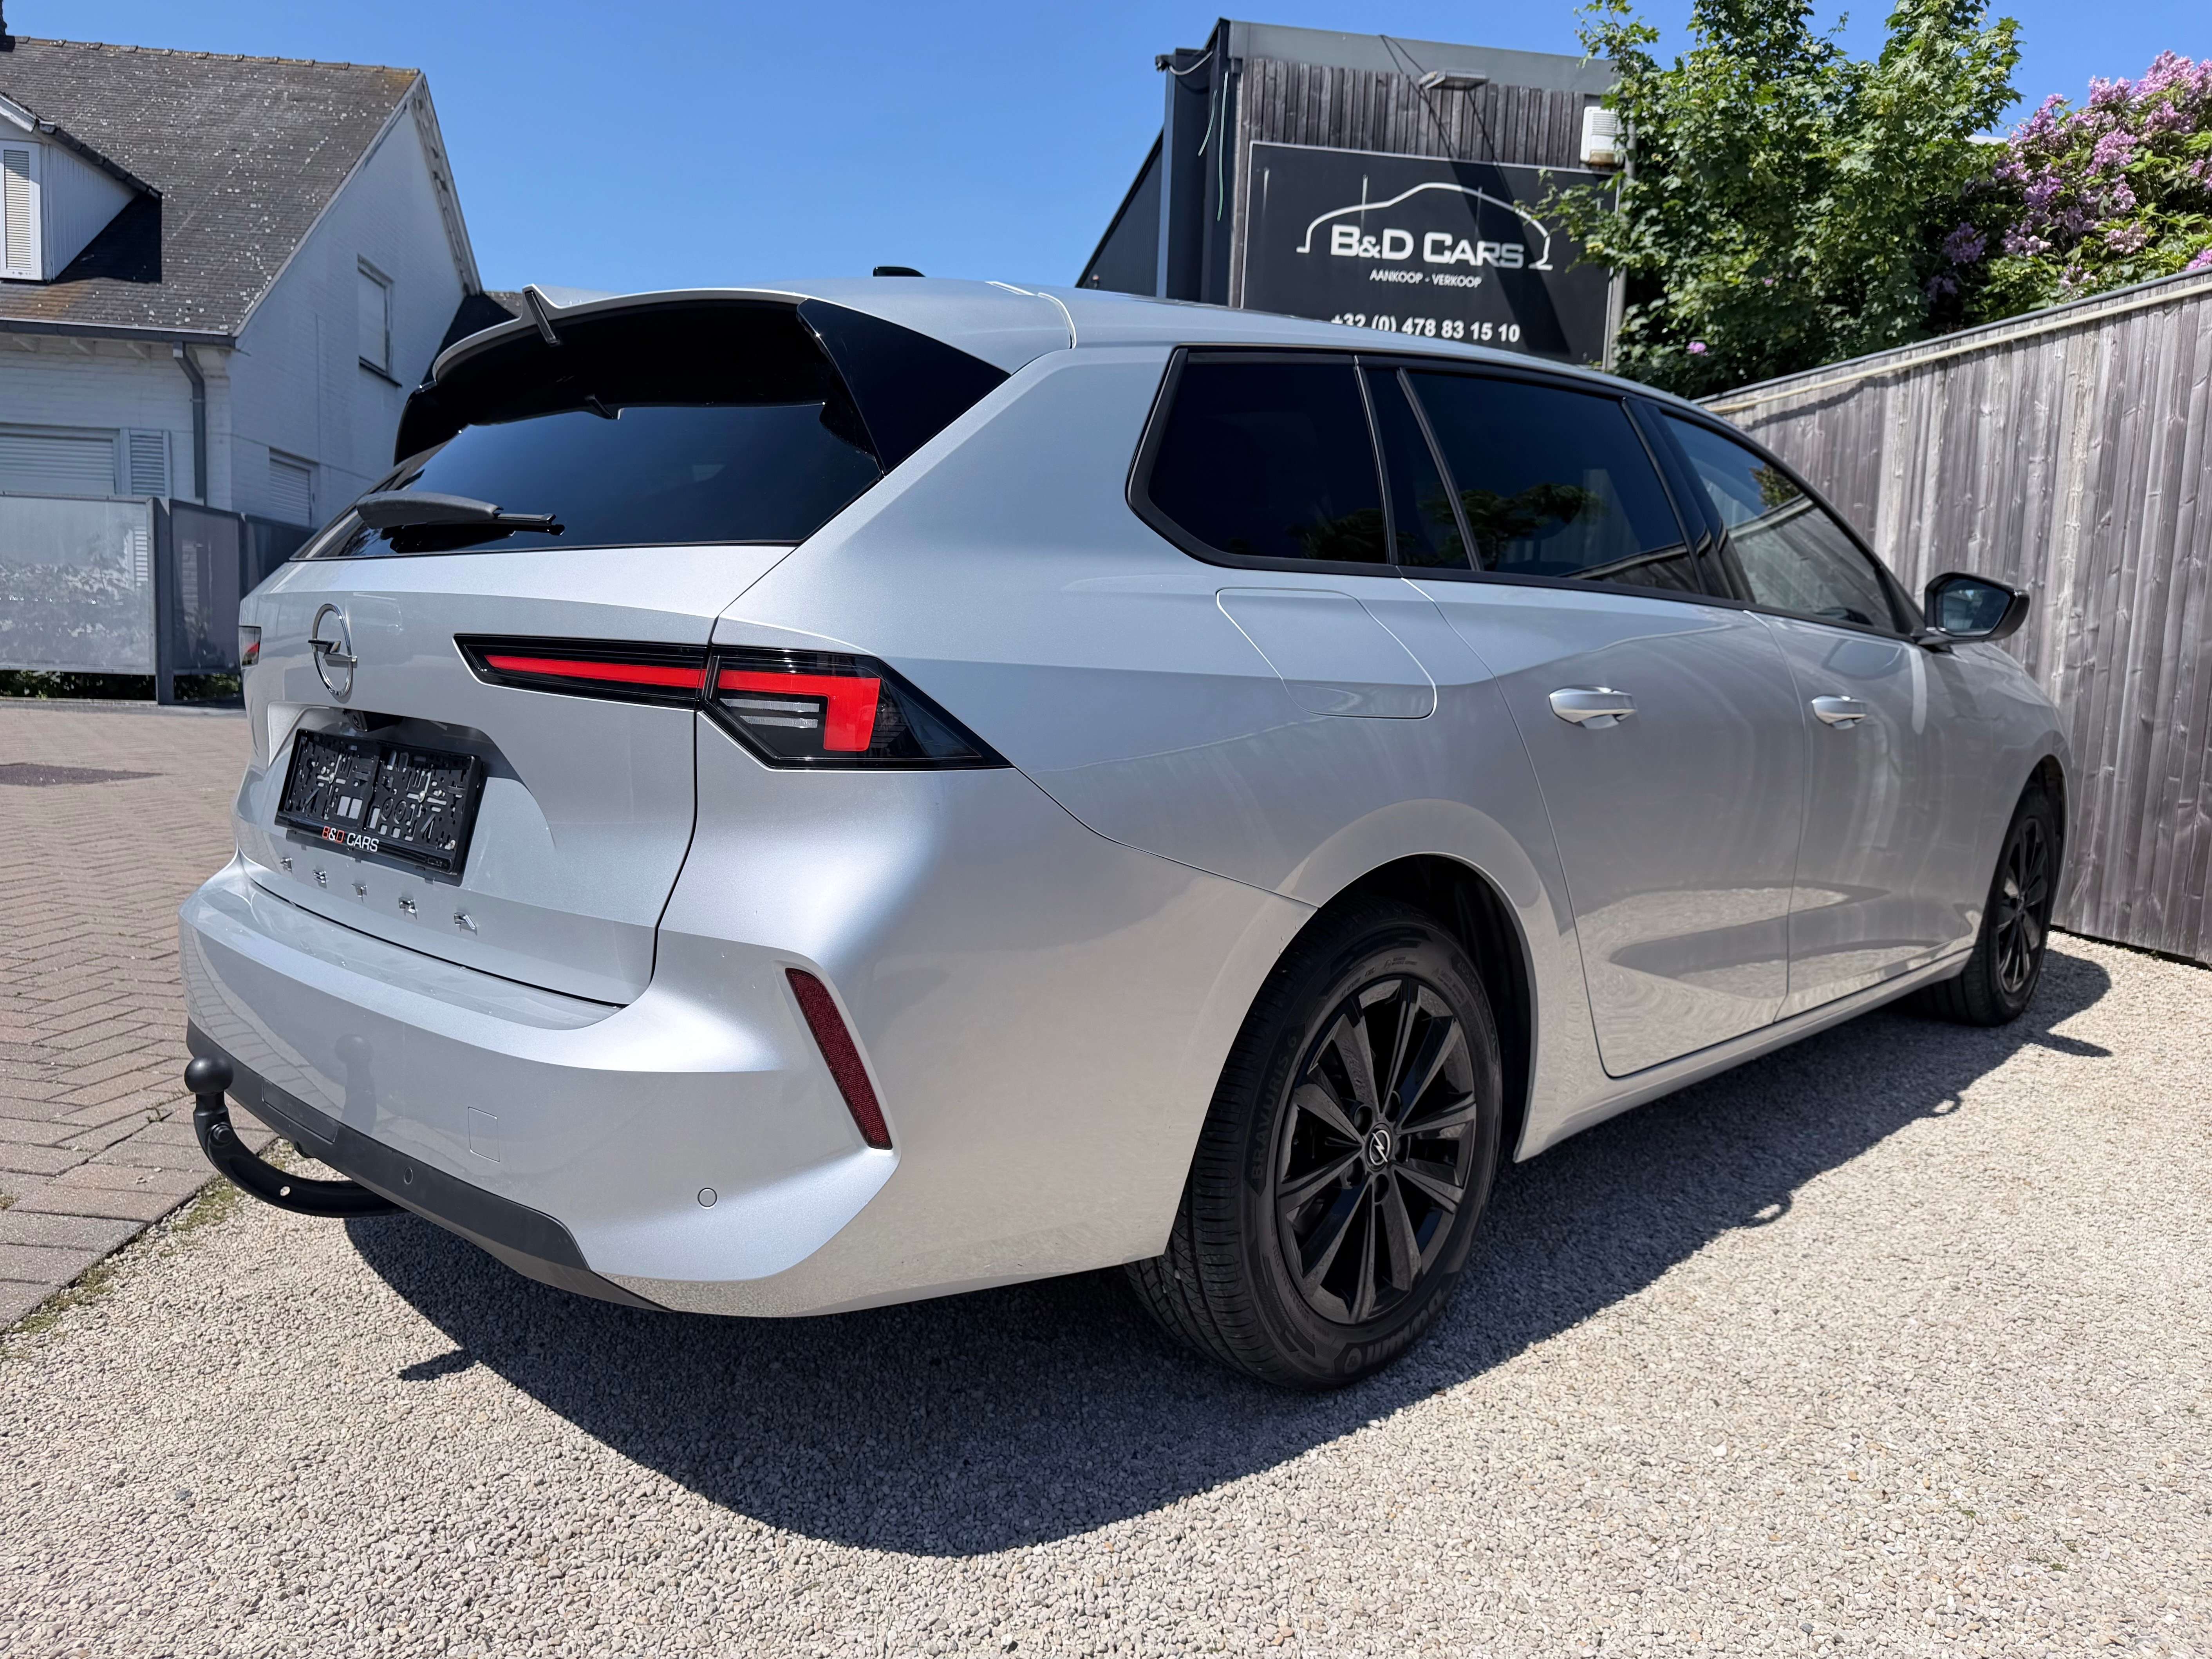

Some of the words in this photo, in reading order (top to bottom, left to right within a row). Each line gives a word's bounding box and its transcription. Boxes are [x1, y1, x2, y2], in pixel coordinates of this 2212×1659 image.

[1330, 224, 1414, 260] B&D
[1423, 231, 1525, 269] CARS
[1369, 268, 1423, 284] AANKOOP
[1431, 273, 1482, 288] VERKOOP
[1372, 315, 1397, 332] (0)
[1401, 316, 1437, 337] 478
[1441, 319, 1464, 339] 83
[1470, 321, 1493, 341] 15
[1498, 323, 1520, 343] 10
[322, 826, 345, 844] B&D
[347, 832, 379, 852] CARS
